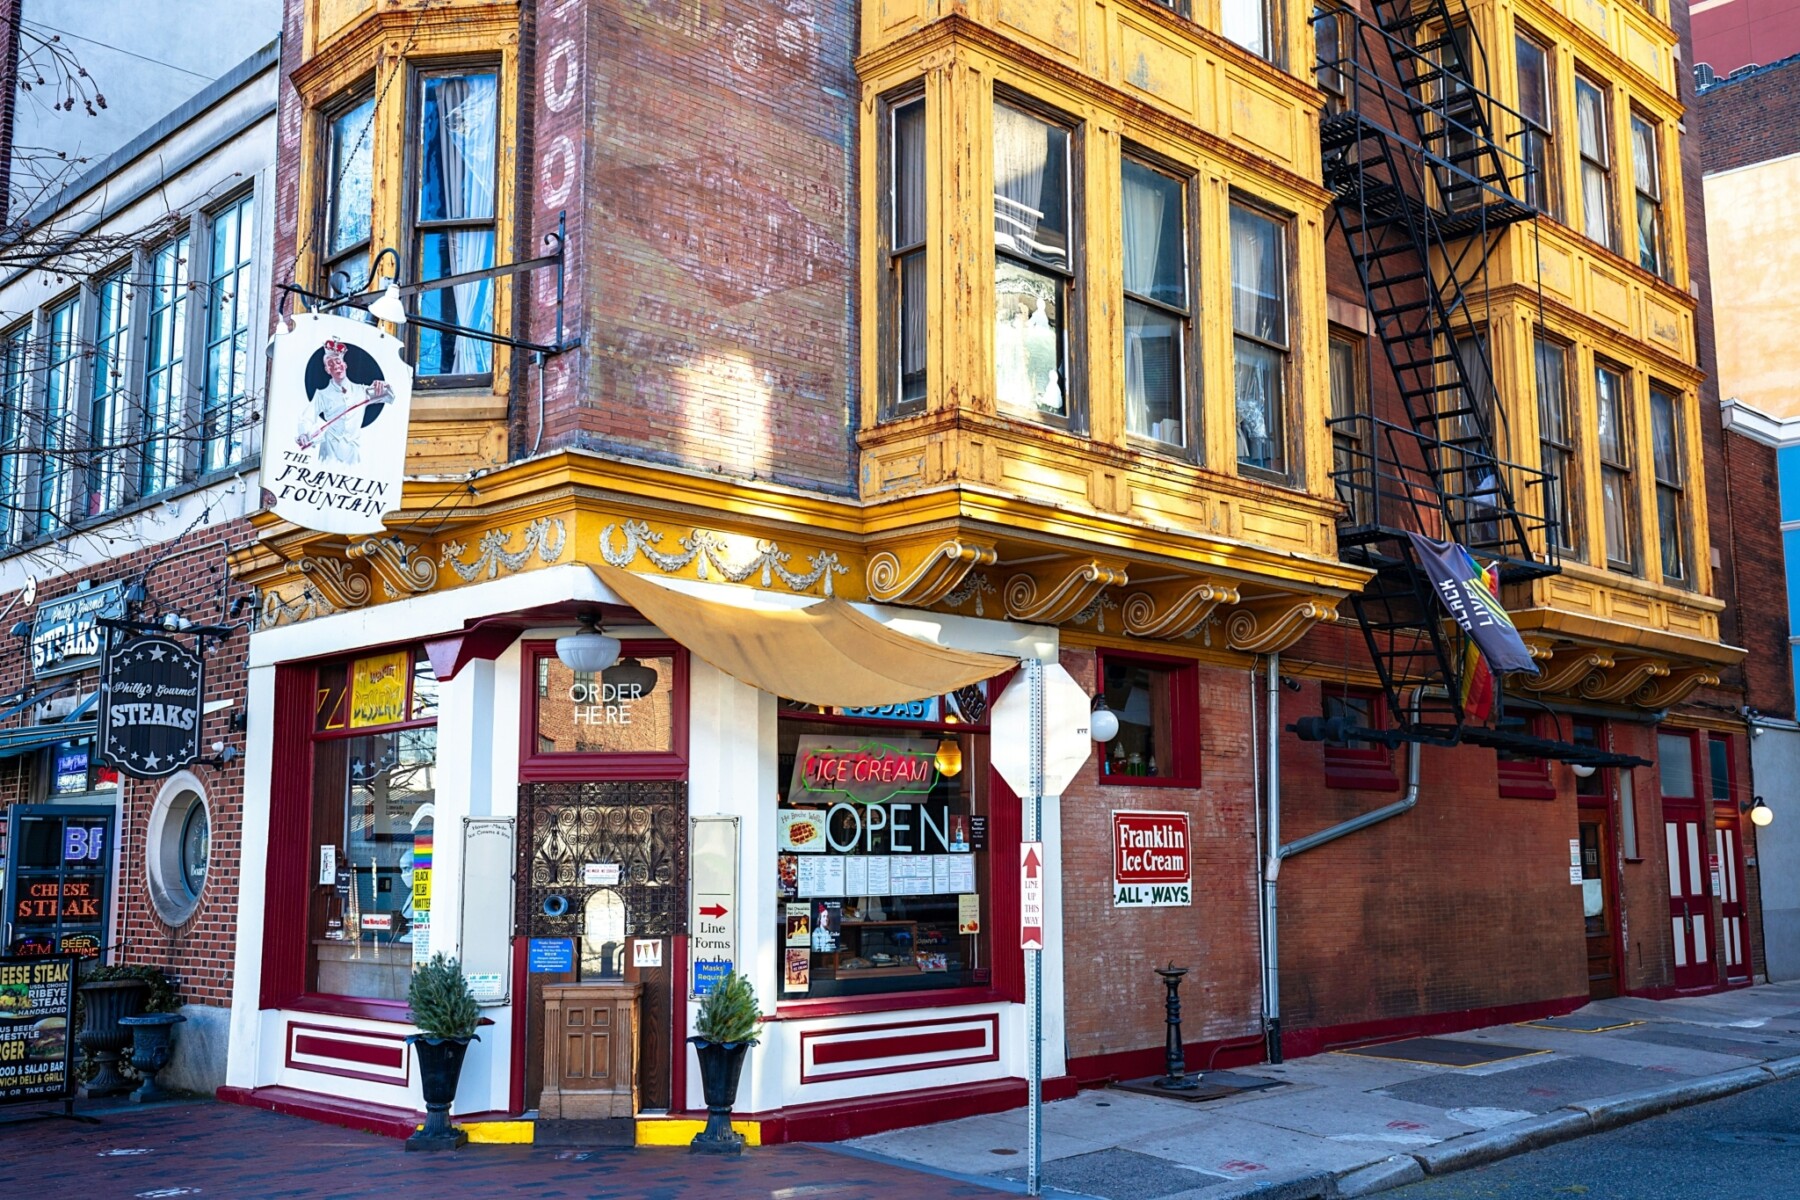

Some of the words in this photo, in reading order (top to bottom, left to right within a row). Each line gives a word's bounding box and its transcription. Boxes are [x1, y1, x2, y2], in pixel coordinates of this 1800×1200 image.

[283, 450, 312, 464] THE
[275, 464, 389, 499] FRANKLIN
[278, 485, 387, 518] FOUNTAIN
[1439, 579, 1473, 631] BLACK
[33, 618, 102, 668] STEAKS
[112, 681, 153, 698] Philly's
[155, 684, 197, 697] Gourmet
[569, 683, 642, 702] ORDER
[110, 703, 197, 731] STEAKS
[574, 705, 632, 725] HERE
[816, 759, 850, 782] ICE
[854, 759, 928, 783] CREAM
[825, 803, 950, 853] OPEN
[1119, 824, 1185, 848] Franklin
[1121, 849, 1142, 871] Ice
[1143, 849, 1185, 871] Cream
[414, 871, 428, 881] BLACK
[1024, 880, 1039, 889] LINE
[1027, 892, 1036, 901] UP
[1024, 904, 1040, 913] THIS
[1024, 916, 1040, 925] WAY
[700, 922, 726, 934] Line
[61, 938, 91, 948] BEER
[695, 937, 731, 949] Forms
[0, 965, 31, 985] EESE
[34, 963, 69, 984] STEAK
[28, 988, 67, 998] RIBEYE
[32, 997, 67, 1008] STEAK
[18, 1007, 67, 1016] HANDSLICED
[0, 1041, 25, 1061] GER
[25, 1062, 48, 1074] SALAD
[50, 1061, 64, 1072] BAR
[20, 1073, 36, 1085] DELI
[44, 1071, 65, 1082] GRILL
[10, 1088, 21, 1096] OR
[25, 1086, 44, 1094] TAKE
